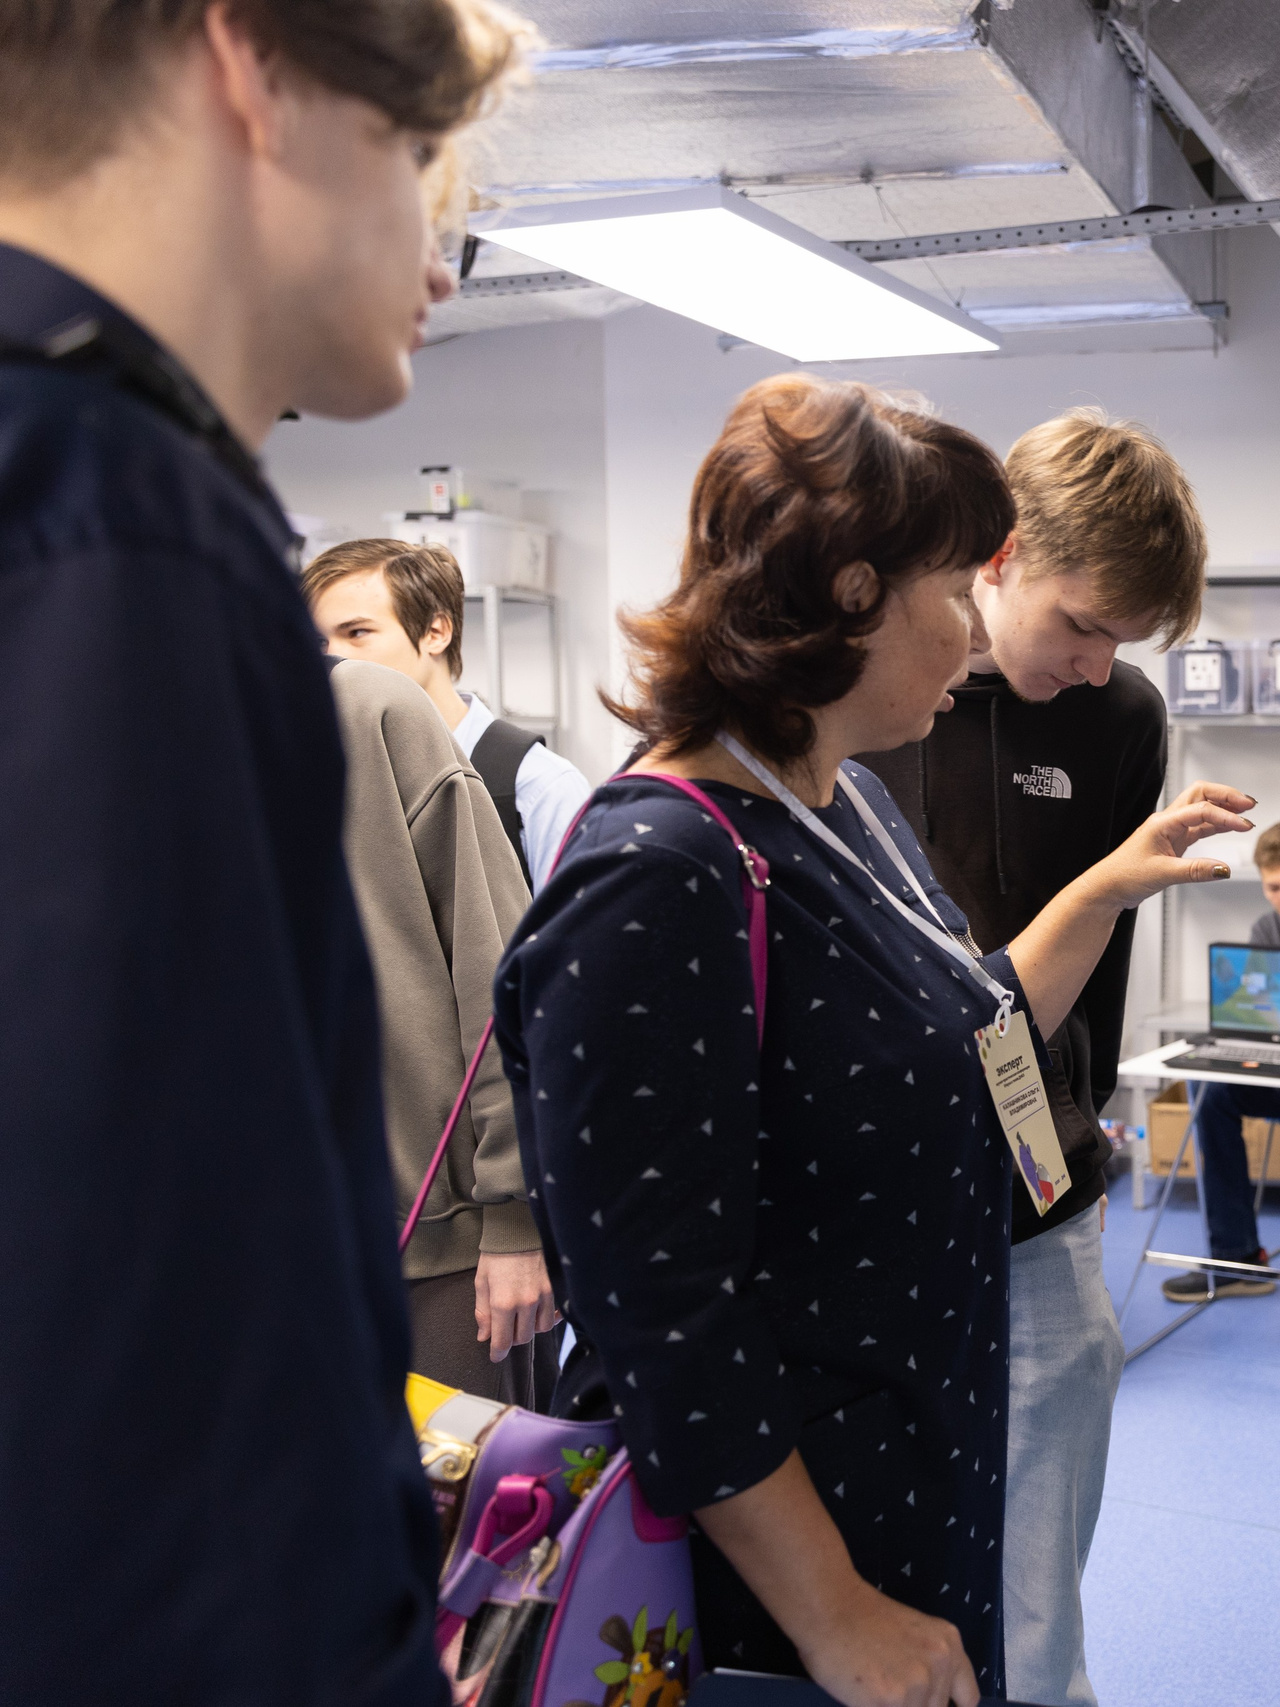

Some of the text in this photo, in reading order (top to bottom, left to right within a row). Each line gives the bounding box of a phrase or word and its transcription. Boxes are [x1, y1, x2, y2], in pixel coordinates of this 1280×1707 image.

[1031, 765, 1053, 777] THE
[1013, 773, 1052, 786] NORTH
[1023, 784, 1051, 797] FACE
